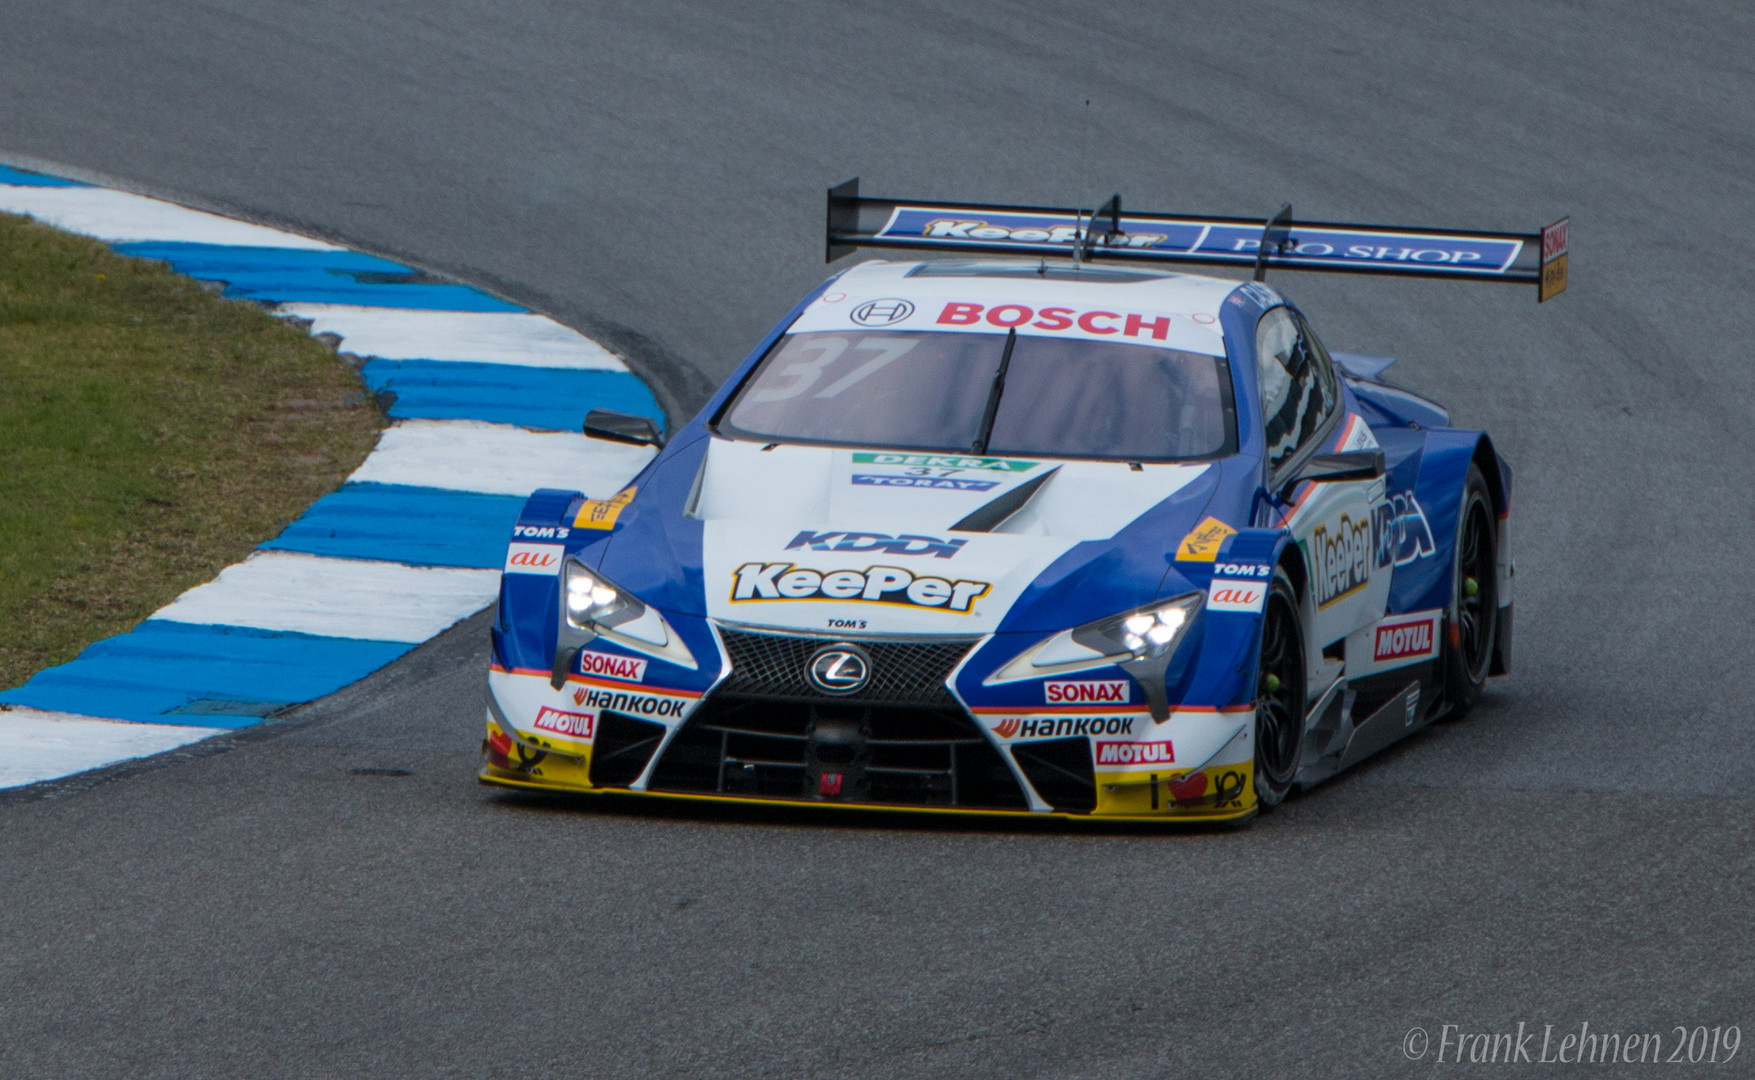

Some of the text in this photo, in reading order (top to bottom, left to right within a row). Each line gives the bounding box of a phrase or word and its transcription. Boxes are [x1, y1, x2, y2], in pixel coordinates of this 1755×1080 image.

[1344, 244, 1481, 264] SHOP
[936, 302, 1170, 341] BOSCH
[752, 337, 921, 401] 37
[873, 455, 1012, 471] DEKRA
[904, 466, 965, 477] 37
[513, 526, 570, 539] TOM'S
[510, 552, 557, 567] au
[1314, 512, 1369, 612] KeePer
[1213, 563, 1271, 577] TOM'S
[731, 562, 993, 614] KeePer
[1213, 589, 1260, 604] au
[826, 619, 868, 630] TOM'S
[1376, 624, 1431, 656] MOTUL
[582, 653, 642, 679] SONAX
[1047, 683, 1124, 702] SONAX
[537, 710, 592, 736] MOTUL
[1100, 743, 1172, 763] MOTUL
